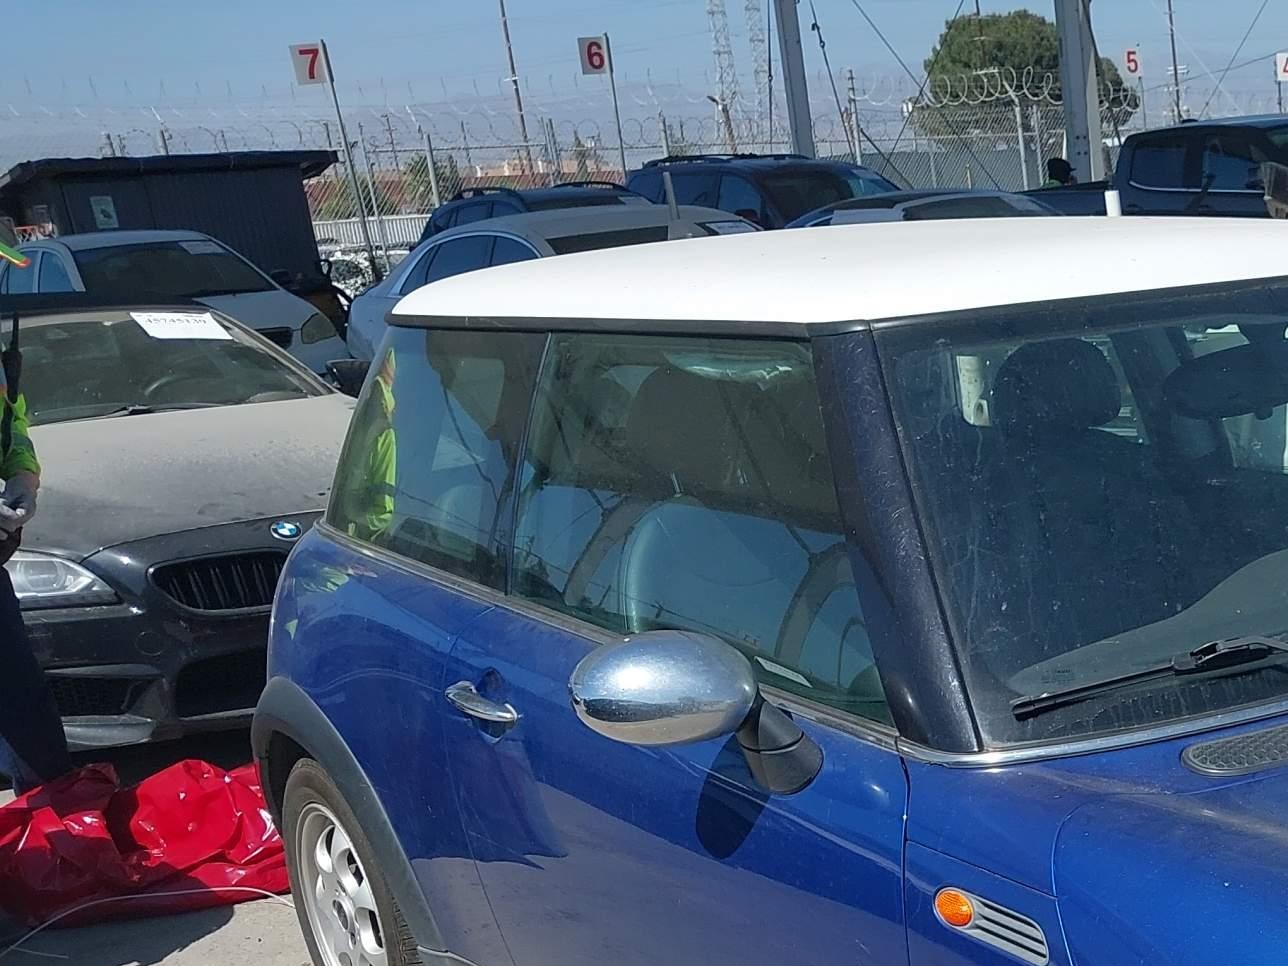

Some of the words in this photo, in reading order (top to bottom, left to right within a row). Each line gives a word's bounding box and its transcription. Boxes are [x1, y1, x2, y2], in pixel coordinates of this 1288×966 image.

[298, 48, 319, 80] 7
[587, 41, 605, 70] 6
[1127, 50, 1138, 73] 5
